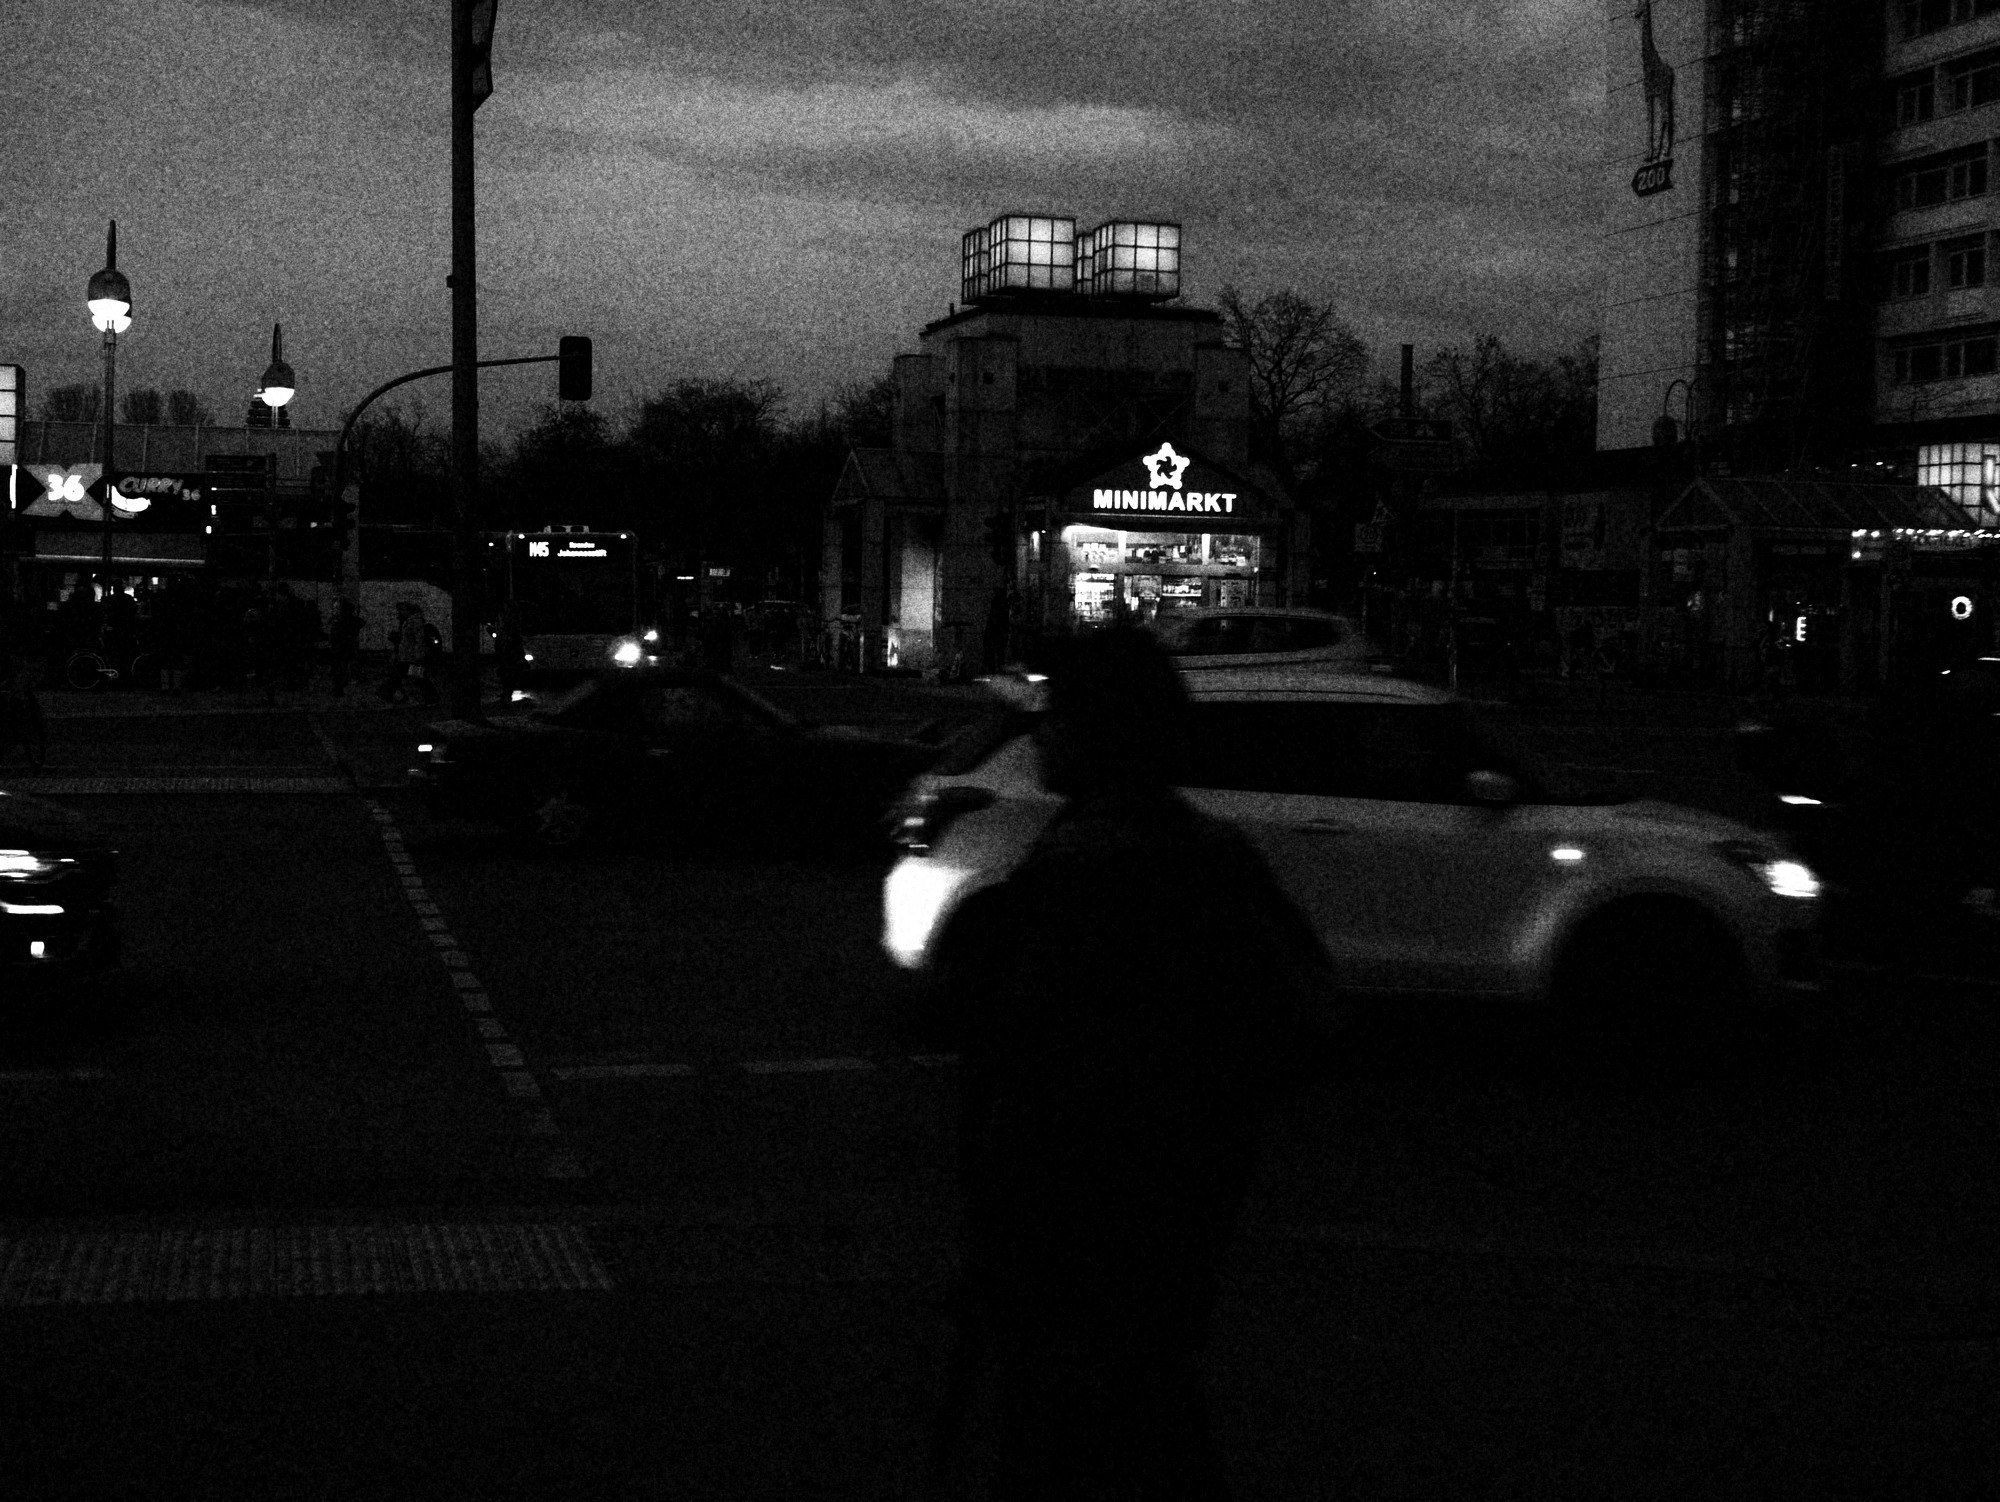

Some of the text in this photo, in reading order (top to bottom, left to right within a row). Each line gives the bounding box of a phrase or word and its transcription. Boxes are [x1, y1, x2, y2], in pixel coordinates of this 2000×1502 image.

[48, 474, 85, 501] 36
[118, 477, 202, 502] CURRY 36
[1093, 488, 1238, 513] MINIMARKT
